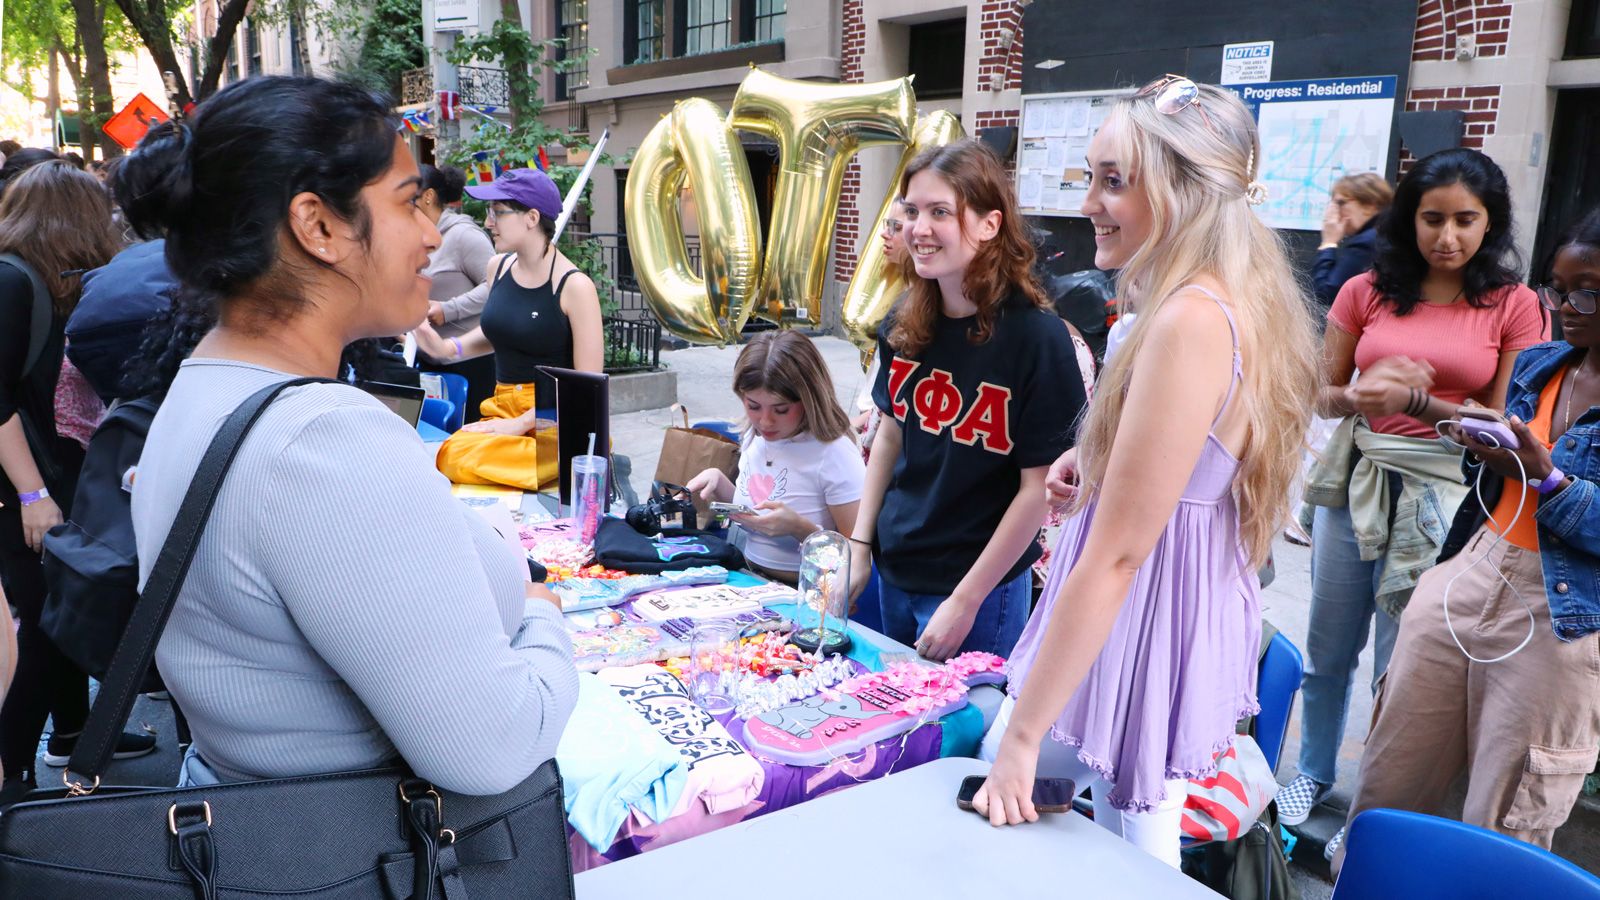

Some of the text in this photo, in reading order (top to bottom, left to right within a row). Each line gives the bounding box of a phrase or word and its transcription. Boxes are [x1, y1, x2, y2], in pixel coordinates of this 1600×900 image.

[1227, 46, 1269, 58] NOTICE
[1243, 86, 1302, 100] Progress:
[1307, 81, 1383, 96] Residential
